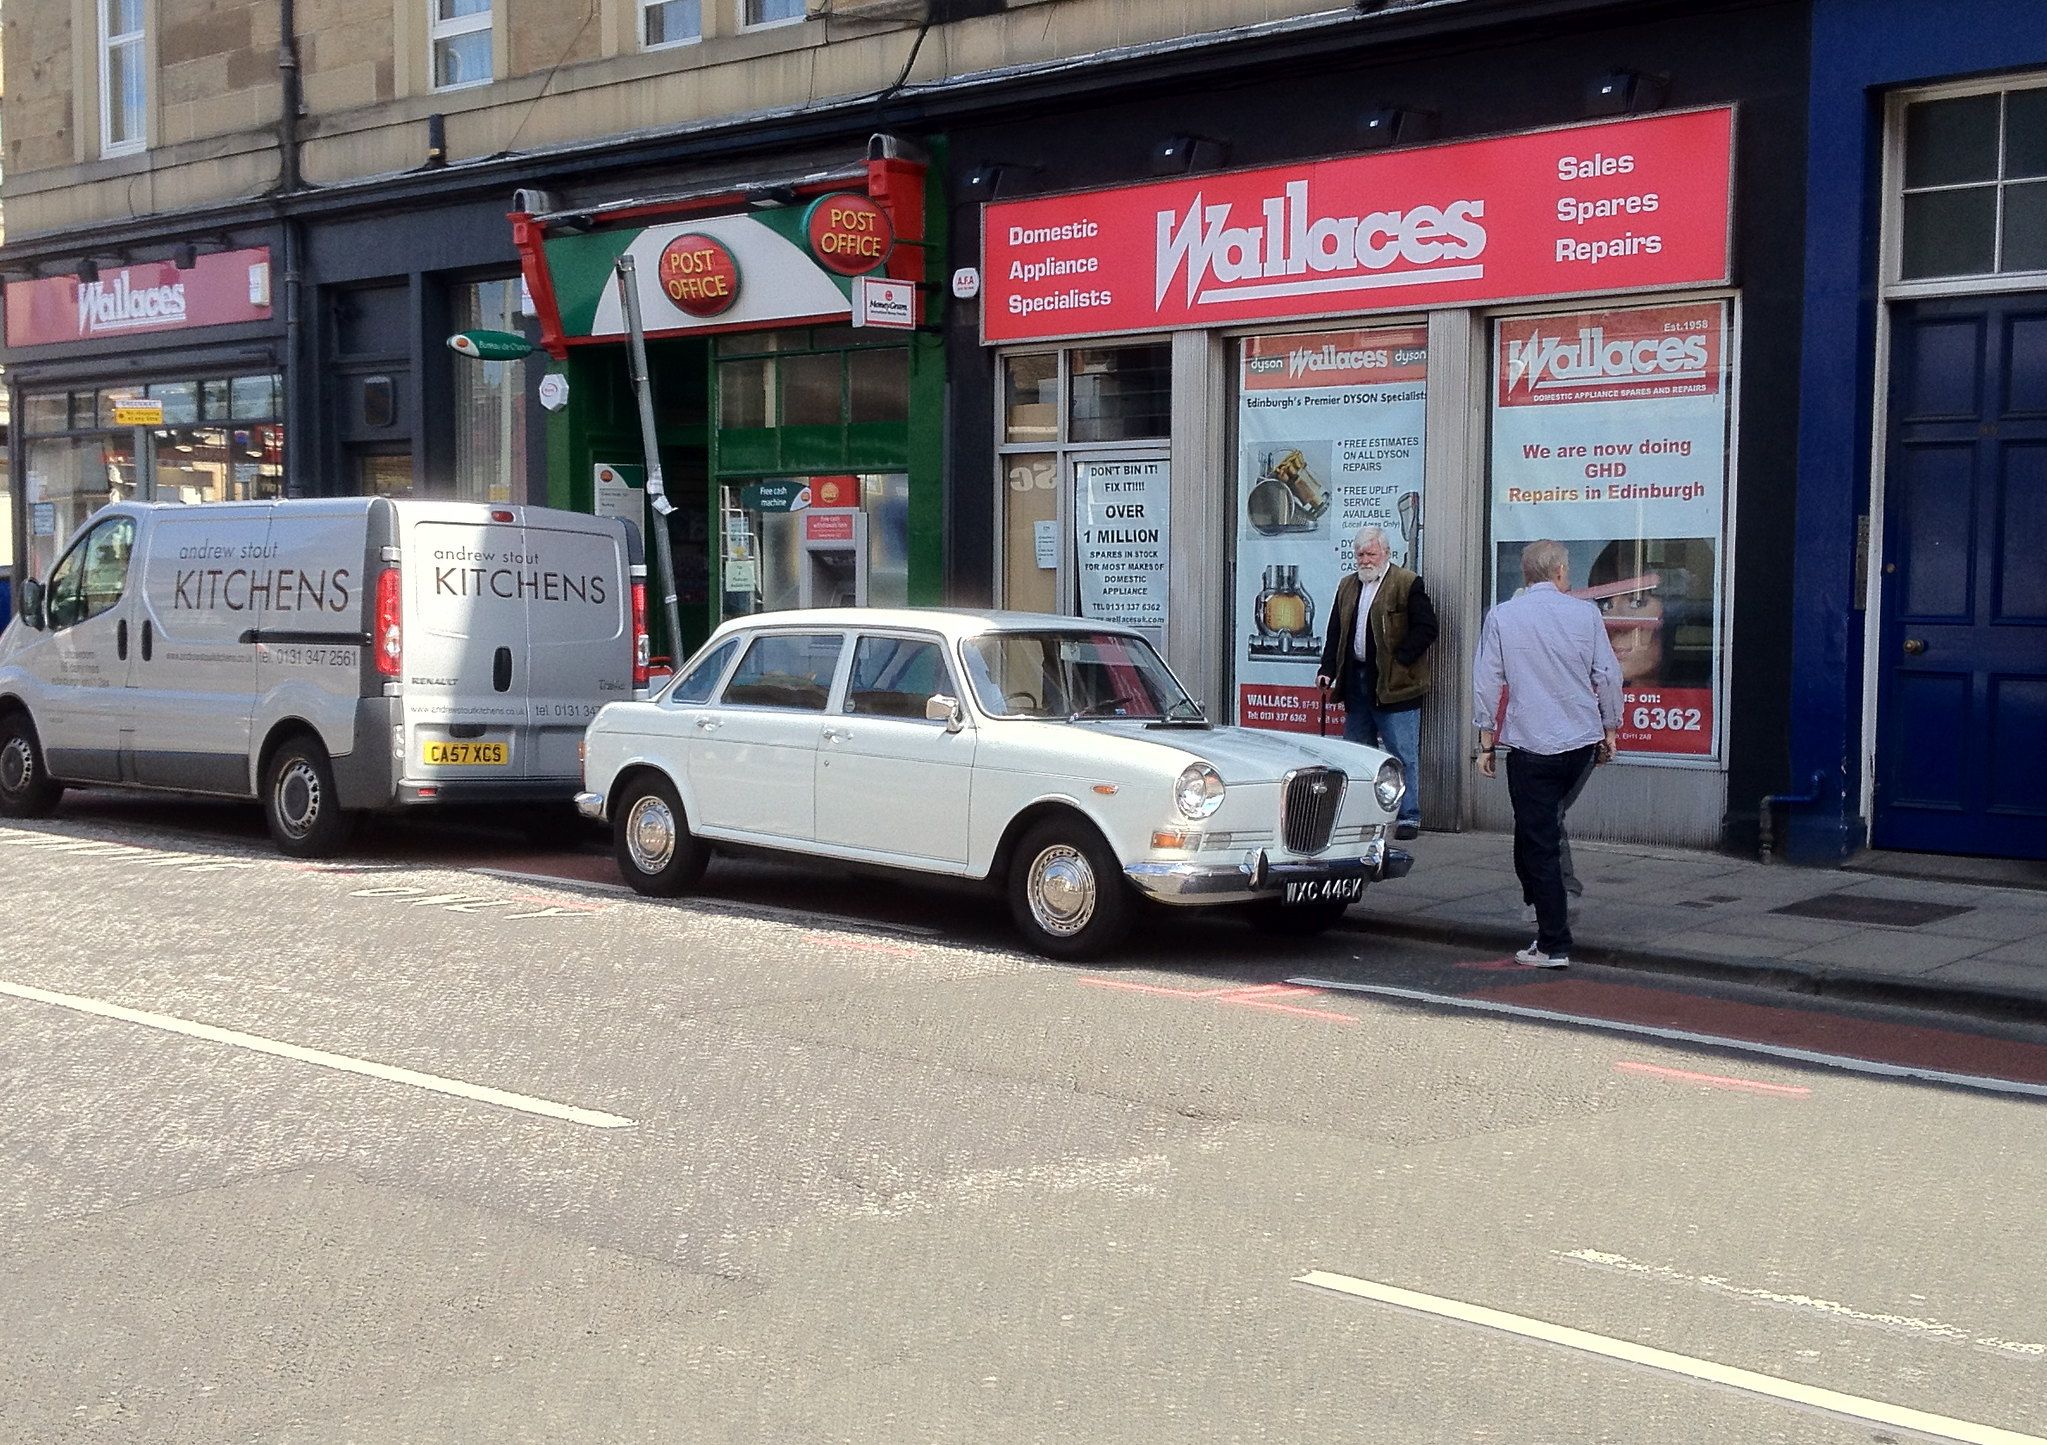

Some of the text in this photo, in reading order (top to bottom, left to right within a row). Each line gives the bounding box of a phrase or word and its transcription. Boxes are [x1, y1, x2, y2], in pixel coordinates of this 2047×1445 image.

[1558, 153, 1634, 181] Sales
[1557, 193, 1660, 225] Spares
[829, 208, 876, 231] POST
[1009, 218, 1098, 246] Domestic
[821, 232, 881, 257] OFFICE
[1155, 180, 1487, 313] Wallaces
[1556, 232, 1662, 264] Repairs
[670, 249, 715, 274] POST
[1009, 256, 1098, 282] Appliance
[668, 275, 728, 300] OFFICE
[78, 271, 186, 335] Wallaces
[1008, 289, 1112, 316] Specialists
[1251, 357, 1283, 373] dyson
[1289, 345, 1388, 379] Wallaces
[1395, 349, 1426, 364] dyson
[1508, 327, 1709, 393] Wallaces
[1247, 397, 1301, 409] Edinburgh's
[1304, 394, 1340, 406] Premier
[1343, 393, 1378, 404] DYSON
[1533, 384, 1706, 402] DOMESTIC APPLIANCE SPARES AND REPAIRS
[1344, 437, 1419, 448] FREE ESTIMATES
[1523, 439, 1692, 459] We are now doing
[1343, 449, 1409, 460] ON ALL DYSON
[1091, 464, 1158, 477] DON'T BIN IT!
[1343, 462, 1381, 472] REPAIRS
[1584, 462, 1627, 478] GHD
[760, 486, 788, 495] Free cash
[1105, 482, 1120, 492] FIX
[1344, 485, 1399, 495] FREE UPLIFT
[1509, 481, 1705, 504] Repairs in Edinburgh
[760, 498, 787, 507] machine
[1343, 498, 1381, 506] SERVICE
[1105, 504, 1145, 518] OVER
[1342, 509, 1391, 518] AVAILABLE
[1084, 529, 1159, 544] 1 MILLION
[179, 538, 279, 559] andrew stout
[434, 546, 538, 565] andrew stout
[1085, 563, 1164, 571] FOR MOST MAKES OF
[436, 567, 606, 604] KITCHENS
[1105, 575, 1147, 583] DOMESTIC
[174, 568, 350, 612] KITCHENS
[1103, 587, 1148, 595] APPLIANCE
[1105, 603, 1125, 611] 0131
[1127, 603, 1140, 611] 337
[1142, 603, 1161, 611] 6362
[277, 649, 302, 664] 0131
[306, 649, 326, 665] 347
[329, 650, 357, 666] 2561
[411, 677, 458, 686] RENAULT
[1640, 693, 1660, 703] on:
[554, 704, 579, 716] 0131
[1260, 711, 1274, 720] 0131
[1276, 712, 1288, 722] 337
[1289, 713, 1307, 722] 6362
[1633, 707, 1701, 731] 6362
[431, 745, 501, 762] CA57 XCS
[1287, 881, 1318, 902] WXC
